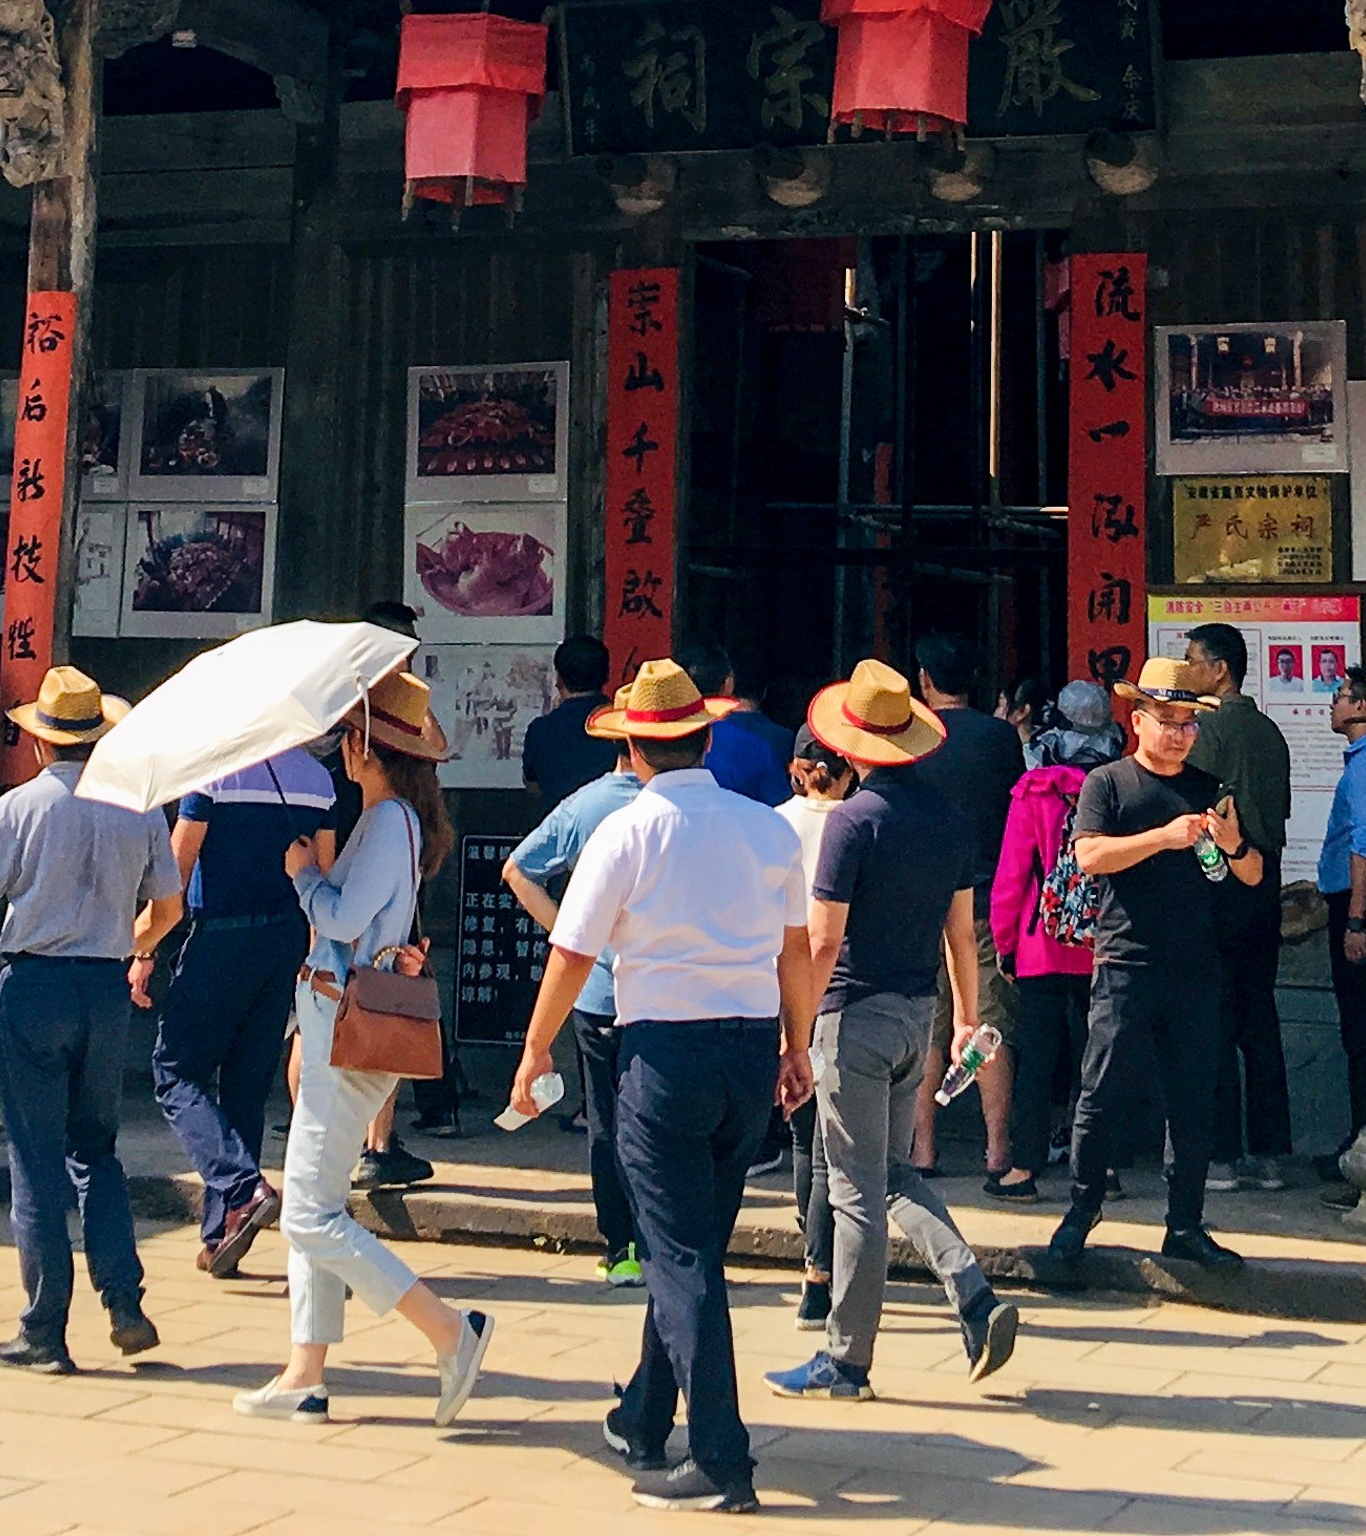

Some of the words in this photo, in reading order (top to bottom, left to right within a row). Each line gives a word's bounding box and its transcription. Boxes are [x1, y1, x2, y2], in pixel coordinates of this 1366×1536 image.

[1190, 512, 1315, 541] 严氏宗祠
[465, 893, 526, 910] 正在实
